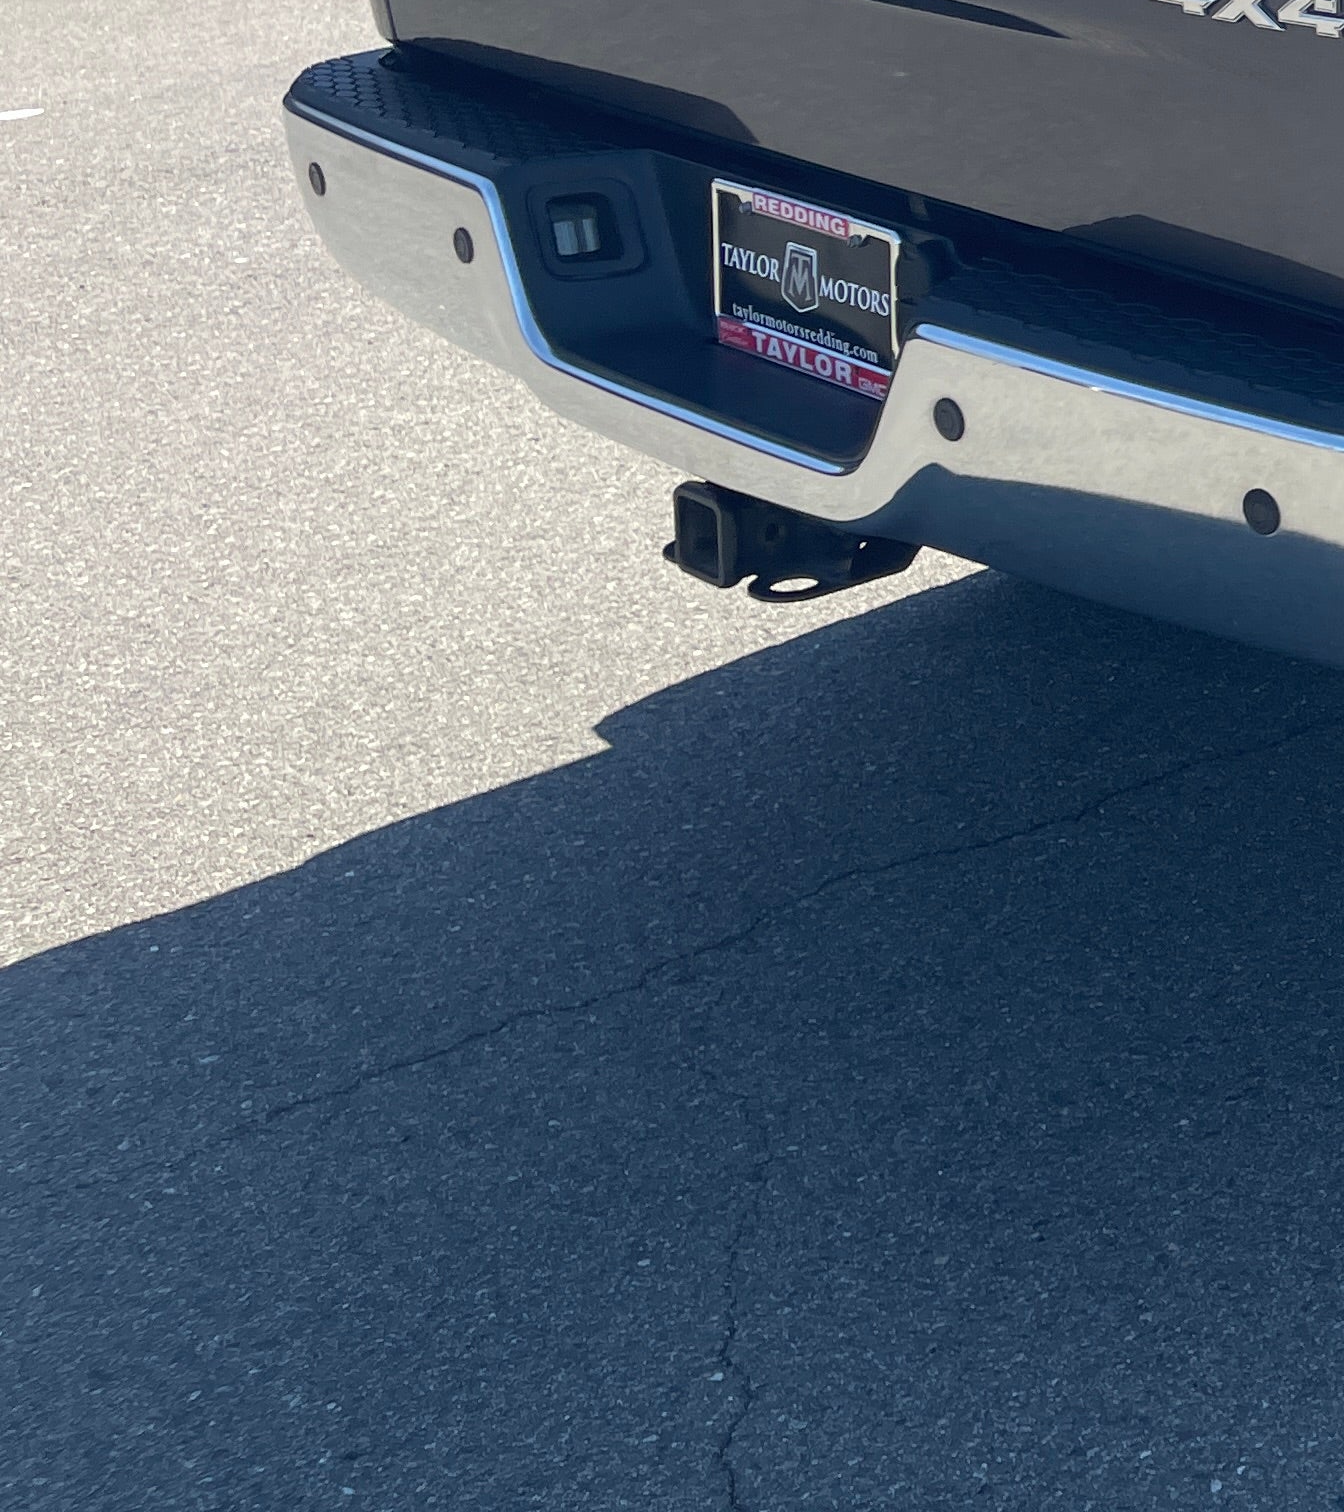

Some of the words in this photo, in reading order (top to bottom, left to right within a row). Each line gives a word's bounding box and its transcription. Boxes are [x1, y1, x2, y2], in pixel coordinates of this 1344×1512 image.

[753, 194, 846, 236] REDDING
[721, 242, 780, 283] TAYLOR
[819, 275, 890, 317] MOTORS
[732, 302, 879, 365] taylormotorsredding.com
[751, 331, 852, 385] TAYLOR
